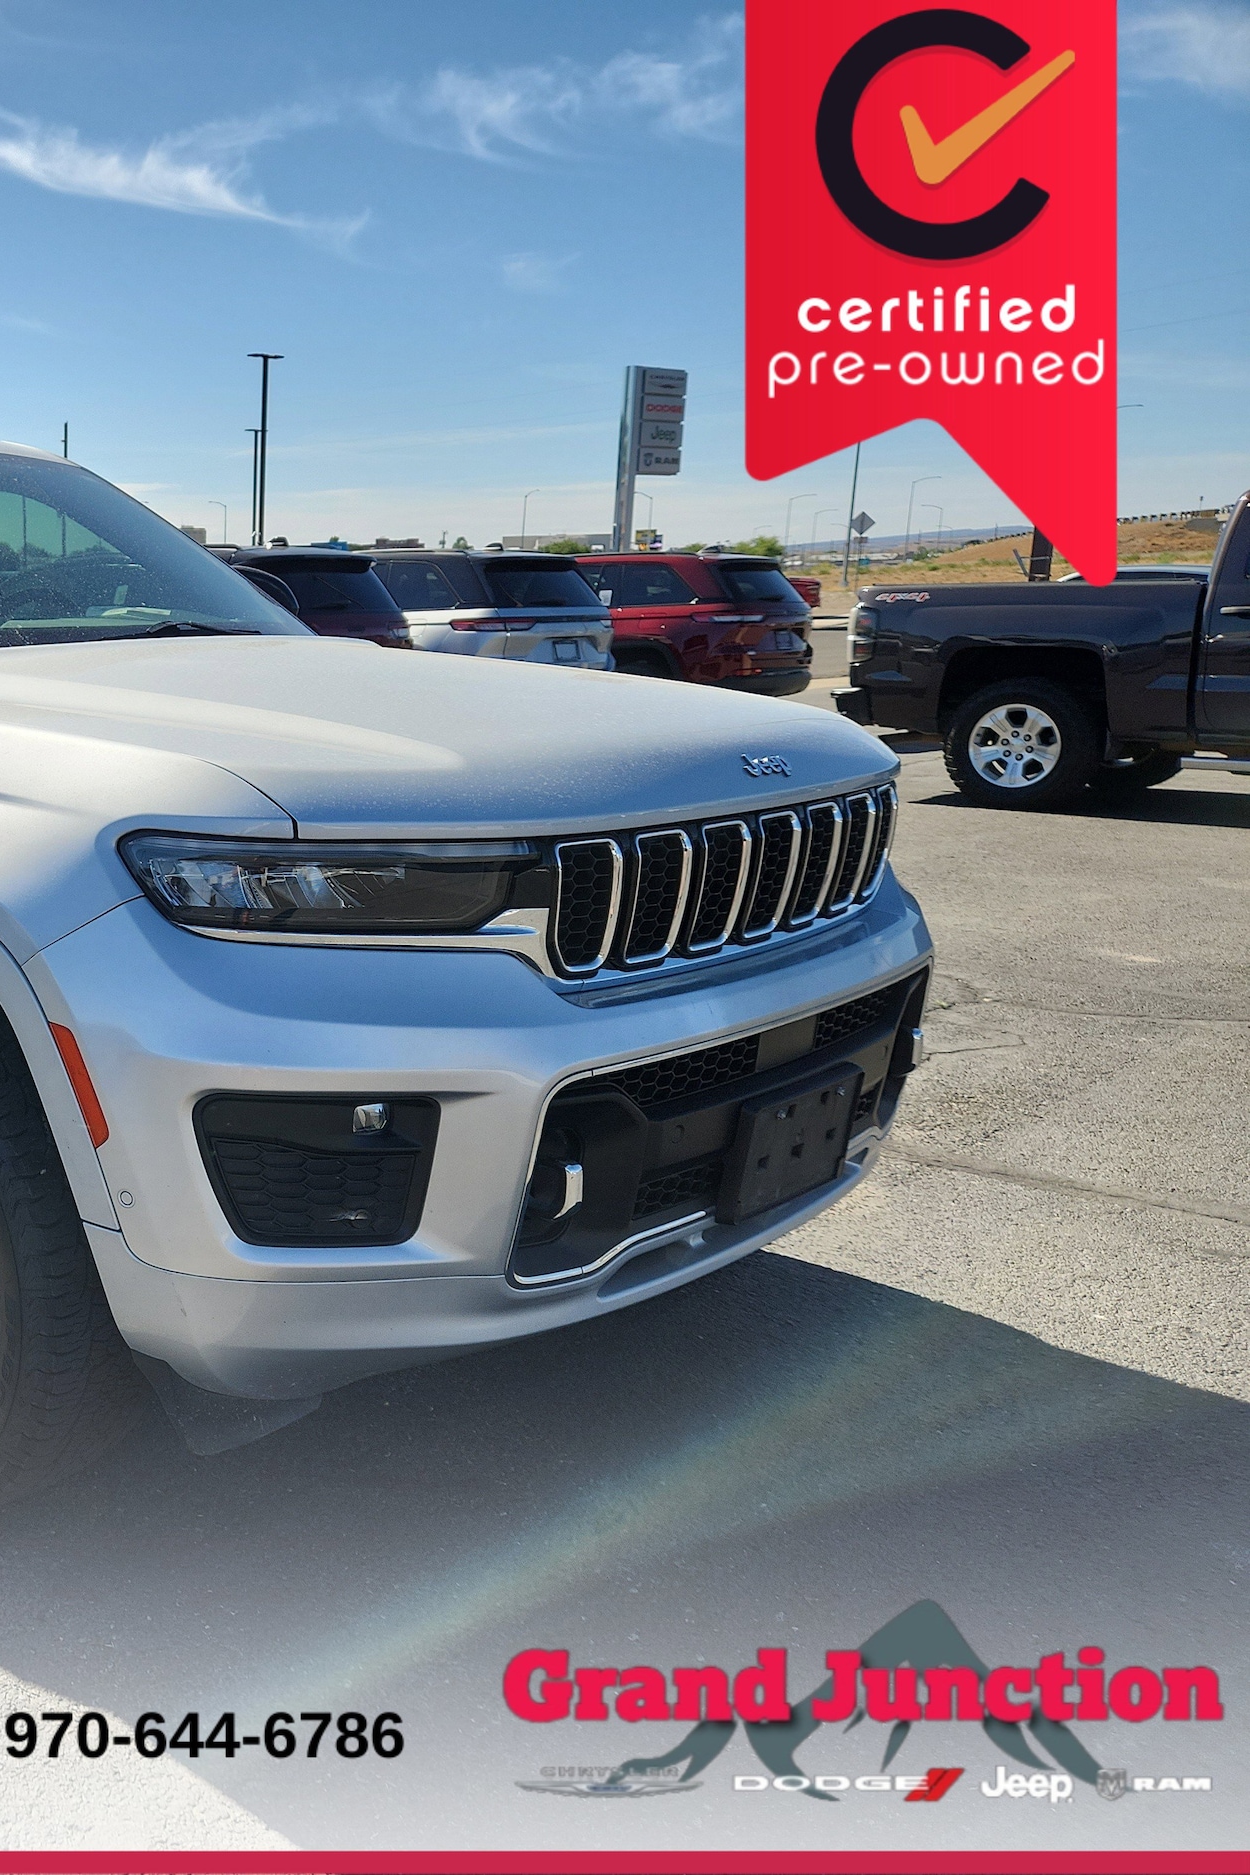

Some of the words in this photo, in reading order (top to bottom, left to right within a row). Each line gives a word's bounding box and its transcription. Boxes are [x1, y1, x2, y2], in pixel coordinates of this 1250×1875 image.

[646, 404, 682, 413] DODGE
[651, 425, 676, 443] Jeep
[741, 753, 792, 777] Jeep
